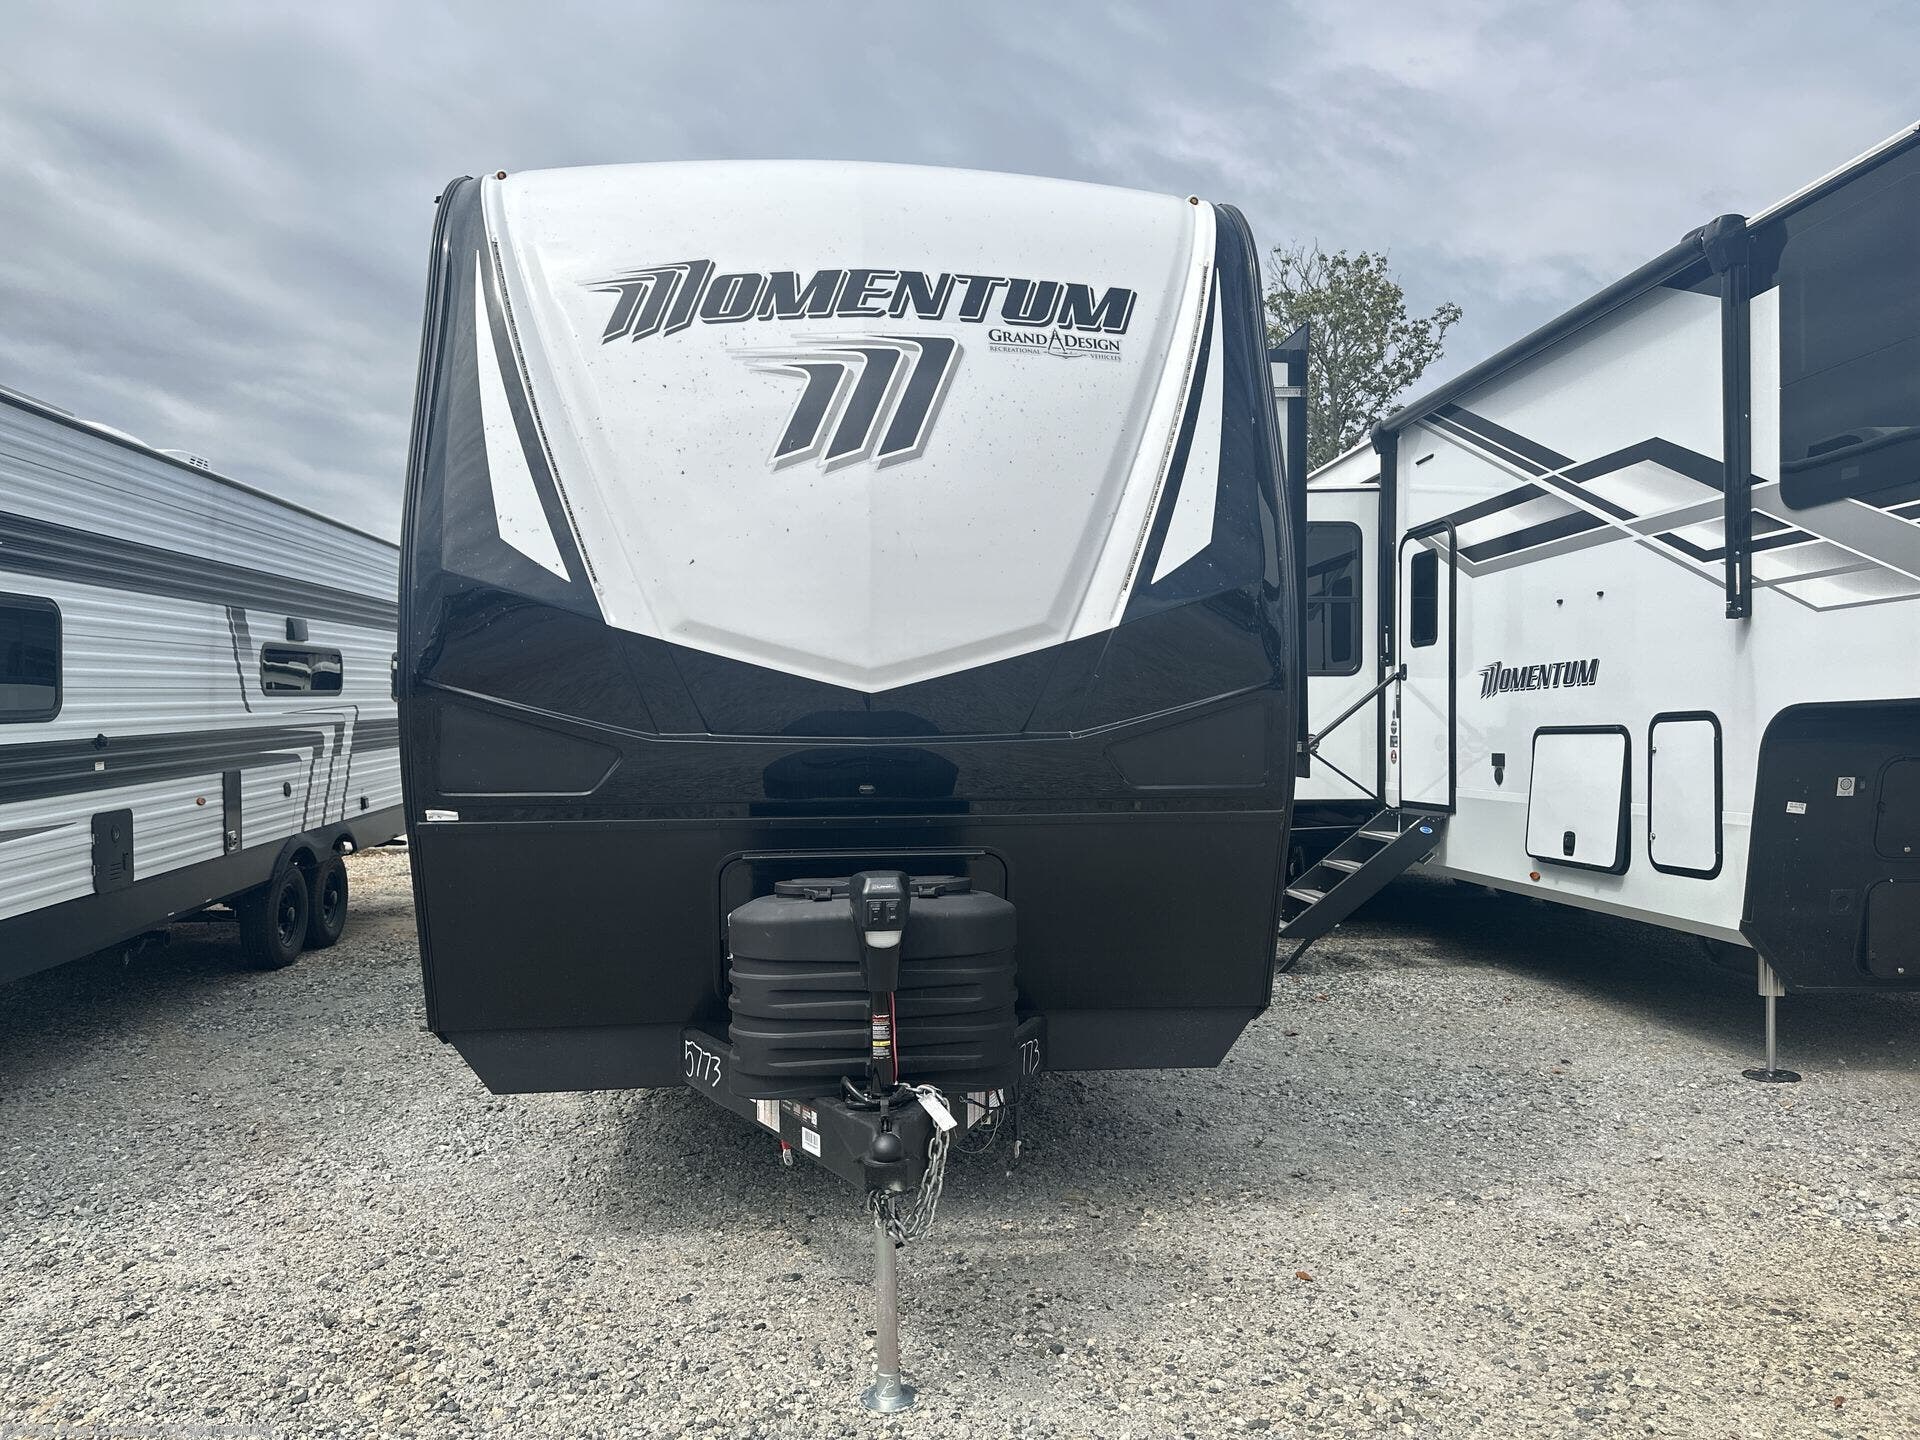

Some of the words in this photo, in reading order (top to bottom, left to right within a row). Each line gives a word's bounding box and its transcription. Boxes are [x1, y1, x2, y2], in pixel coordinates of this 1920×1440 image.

[989, 345, 1040, 355] RECREATIONAL
[1064, 334, 1120, 352] DESIGN
[1477, 658, 1600, 700] MOMENTUM
[685, 1039, 721, 1087] 5773
